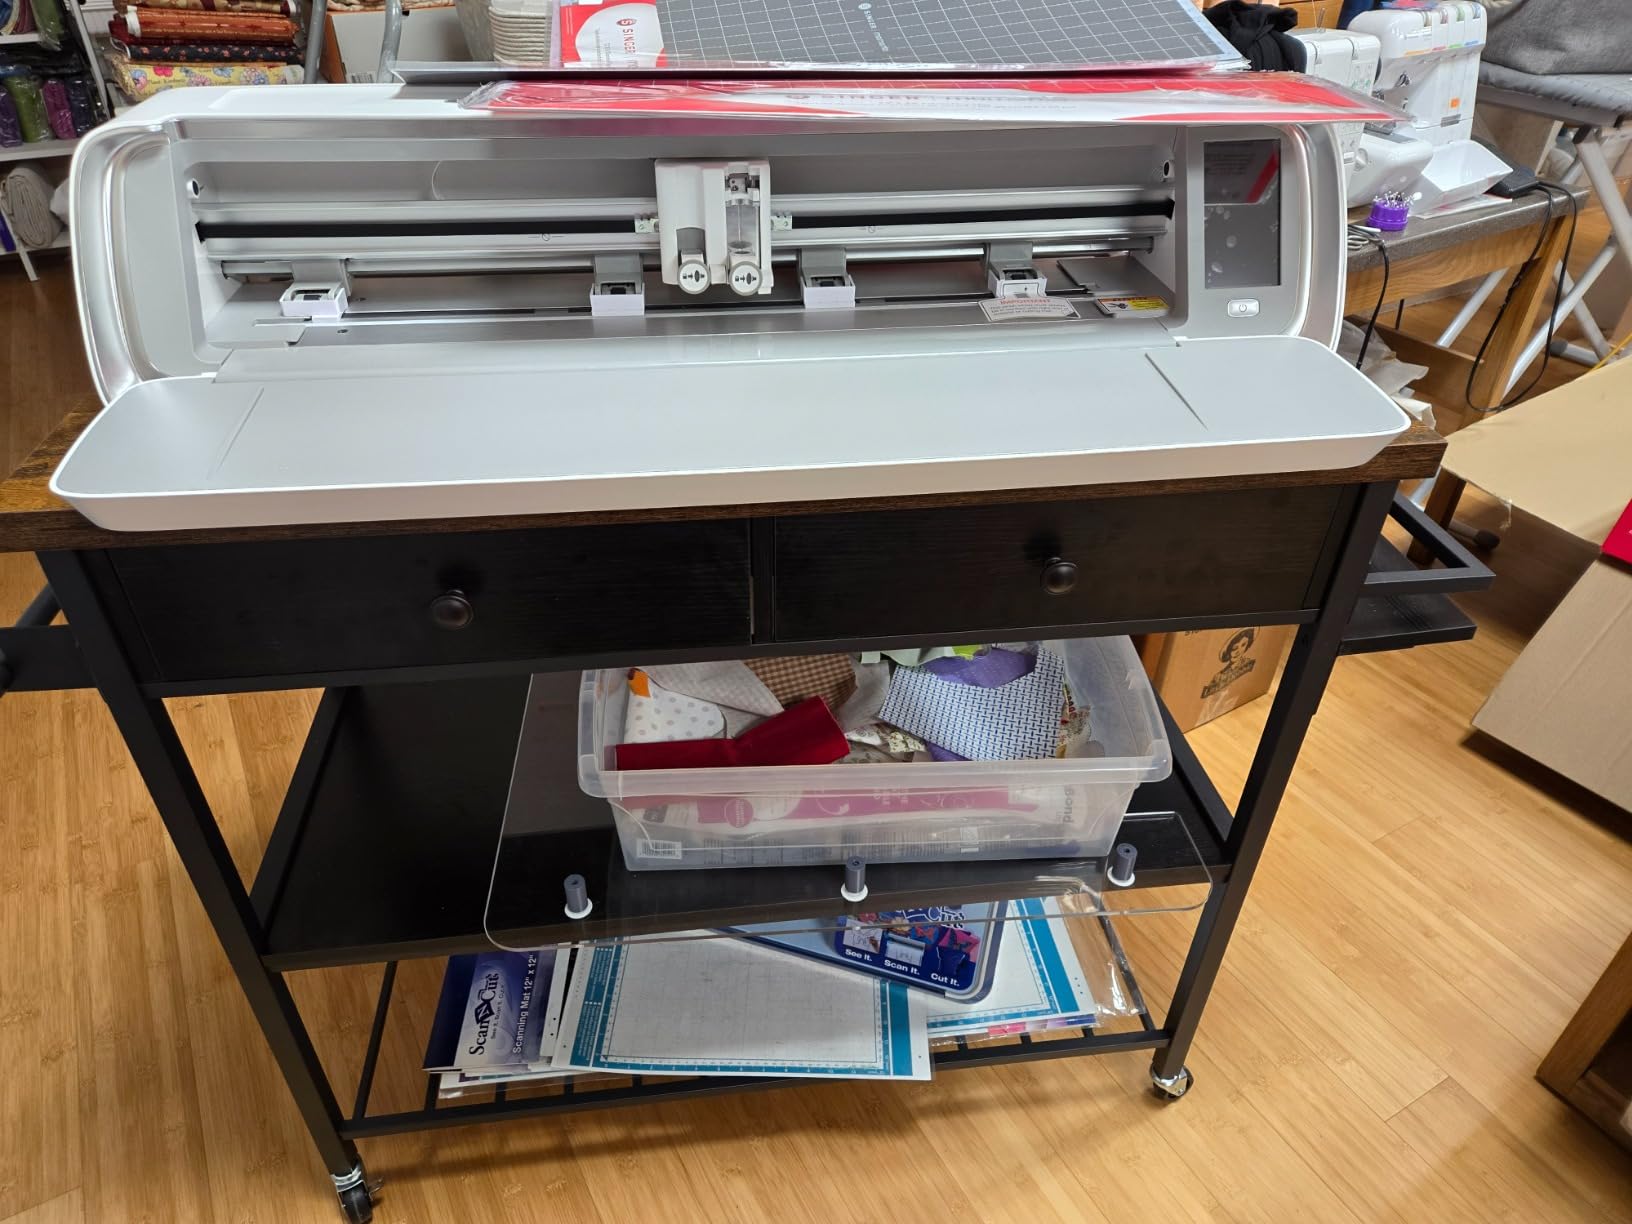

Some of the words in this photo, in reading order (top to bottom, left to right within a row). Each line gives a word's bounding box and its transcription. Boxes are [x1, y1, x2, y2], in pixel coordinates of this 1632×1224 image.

[528, 955, 537, 968] 12"
[845, 949, 862, 959] See
[863, 952, 873, 962] It.
[884, 959, 908, 972] Scan
[910, 966, 920, 976] It.
[523, 977, 533, 989] 12"
[930, 973, 948, 984] Cut
[950, 977, 960, 987] It.
[520, 993, 531, 1009] Mat
[513, 1011, 529, 1054] Scanning
